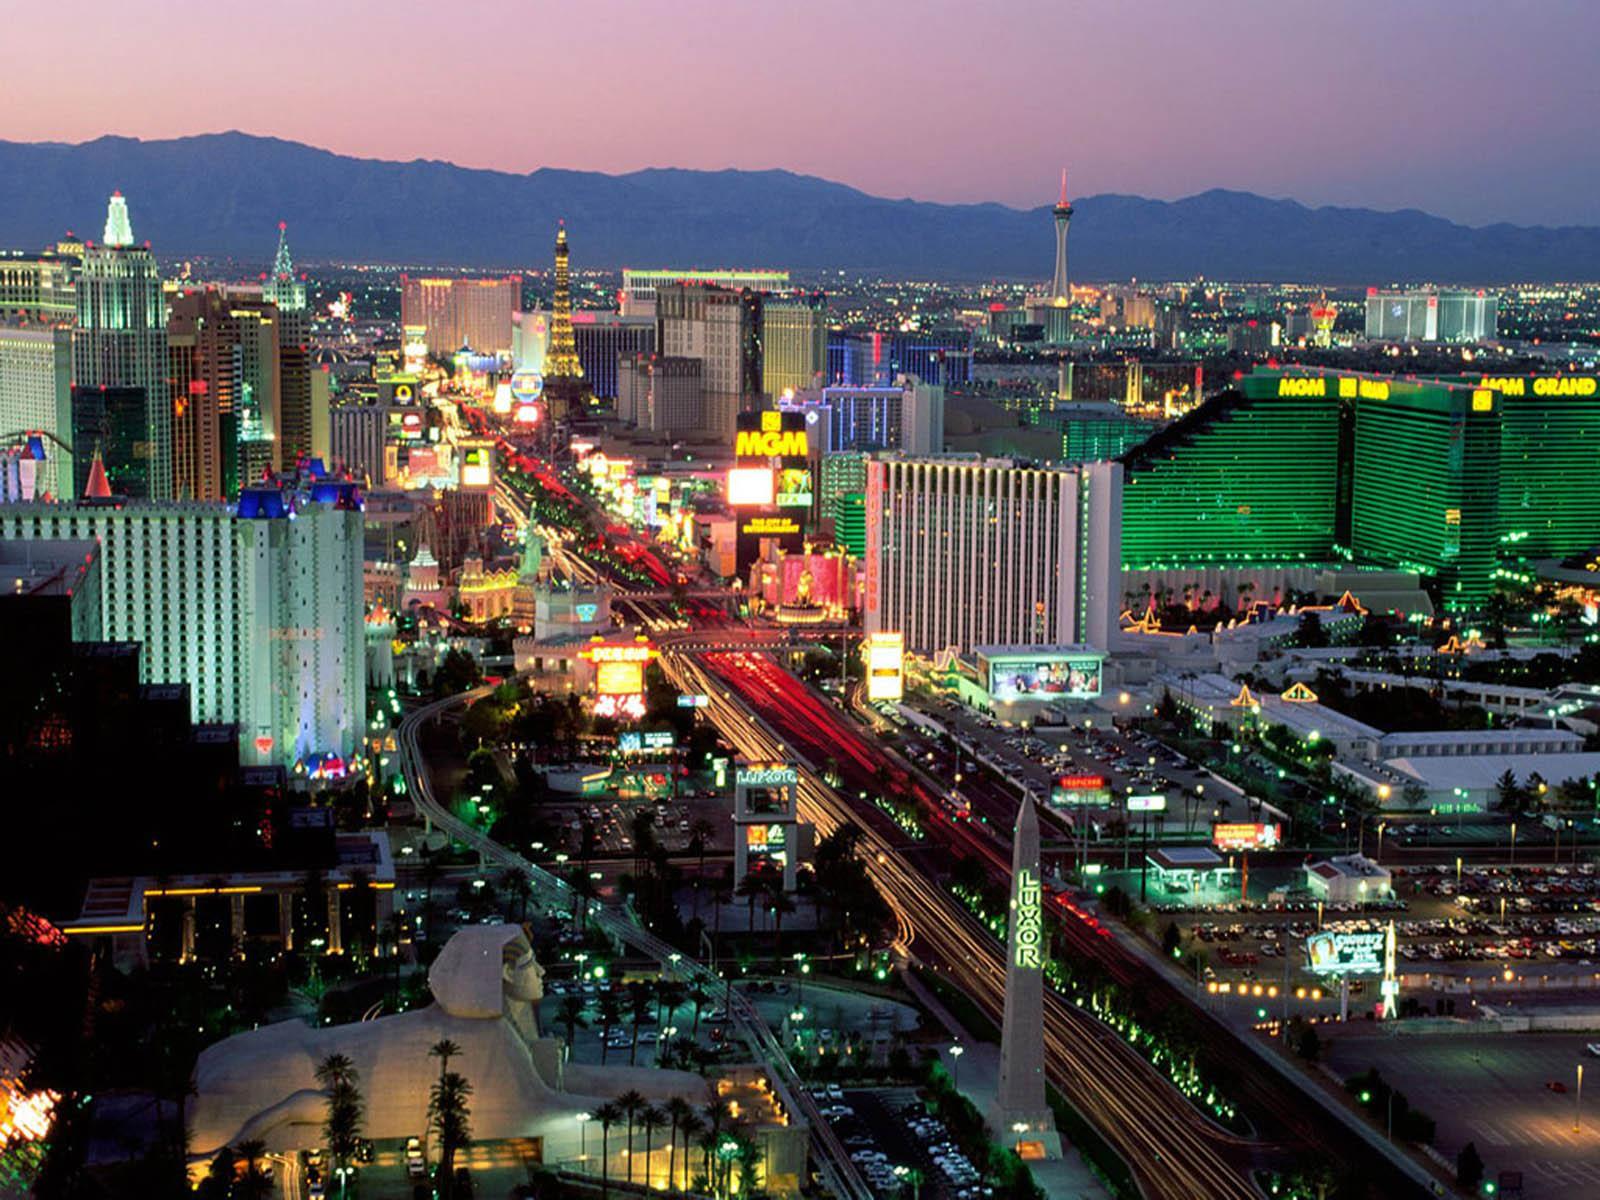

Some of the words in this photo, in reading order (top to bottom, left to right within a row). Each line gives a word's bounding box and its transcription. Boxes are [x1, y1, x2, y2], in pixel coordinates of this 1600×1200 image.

[1279, 378, 1326, 396] MGM
[1533, 378, 1597, 396] GRAND
[736, 431, 809, 456] MGM
[737, 769, 798, 784] LUXOR
[1016, 868, 1041, 968] LUXOR
